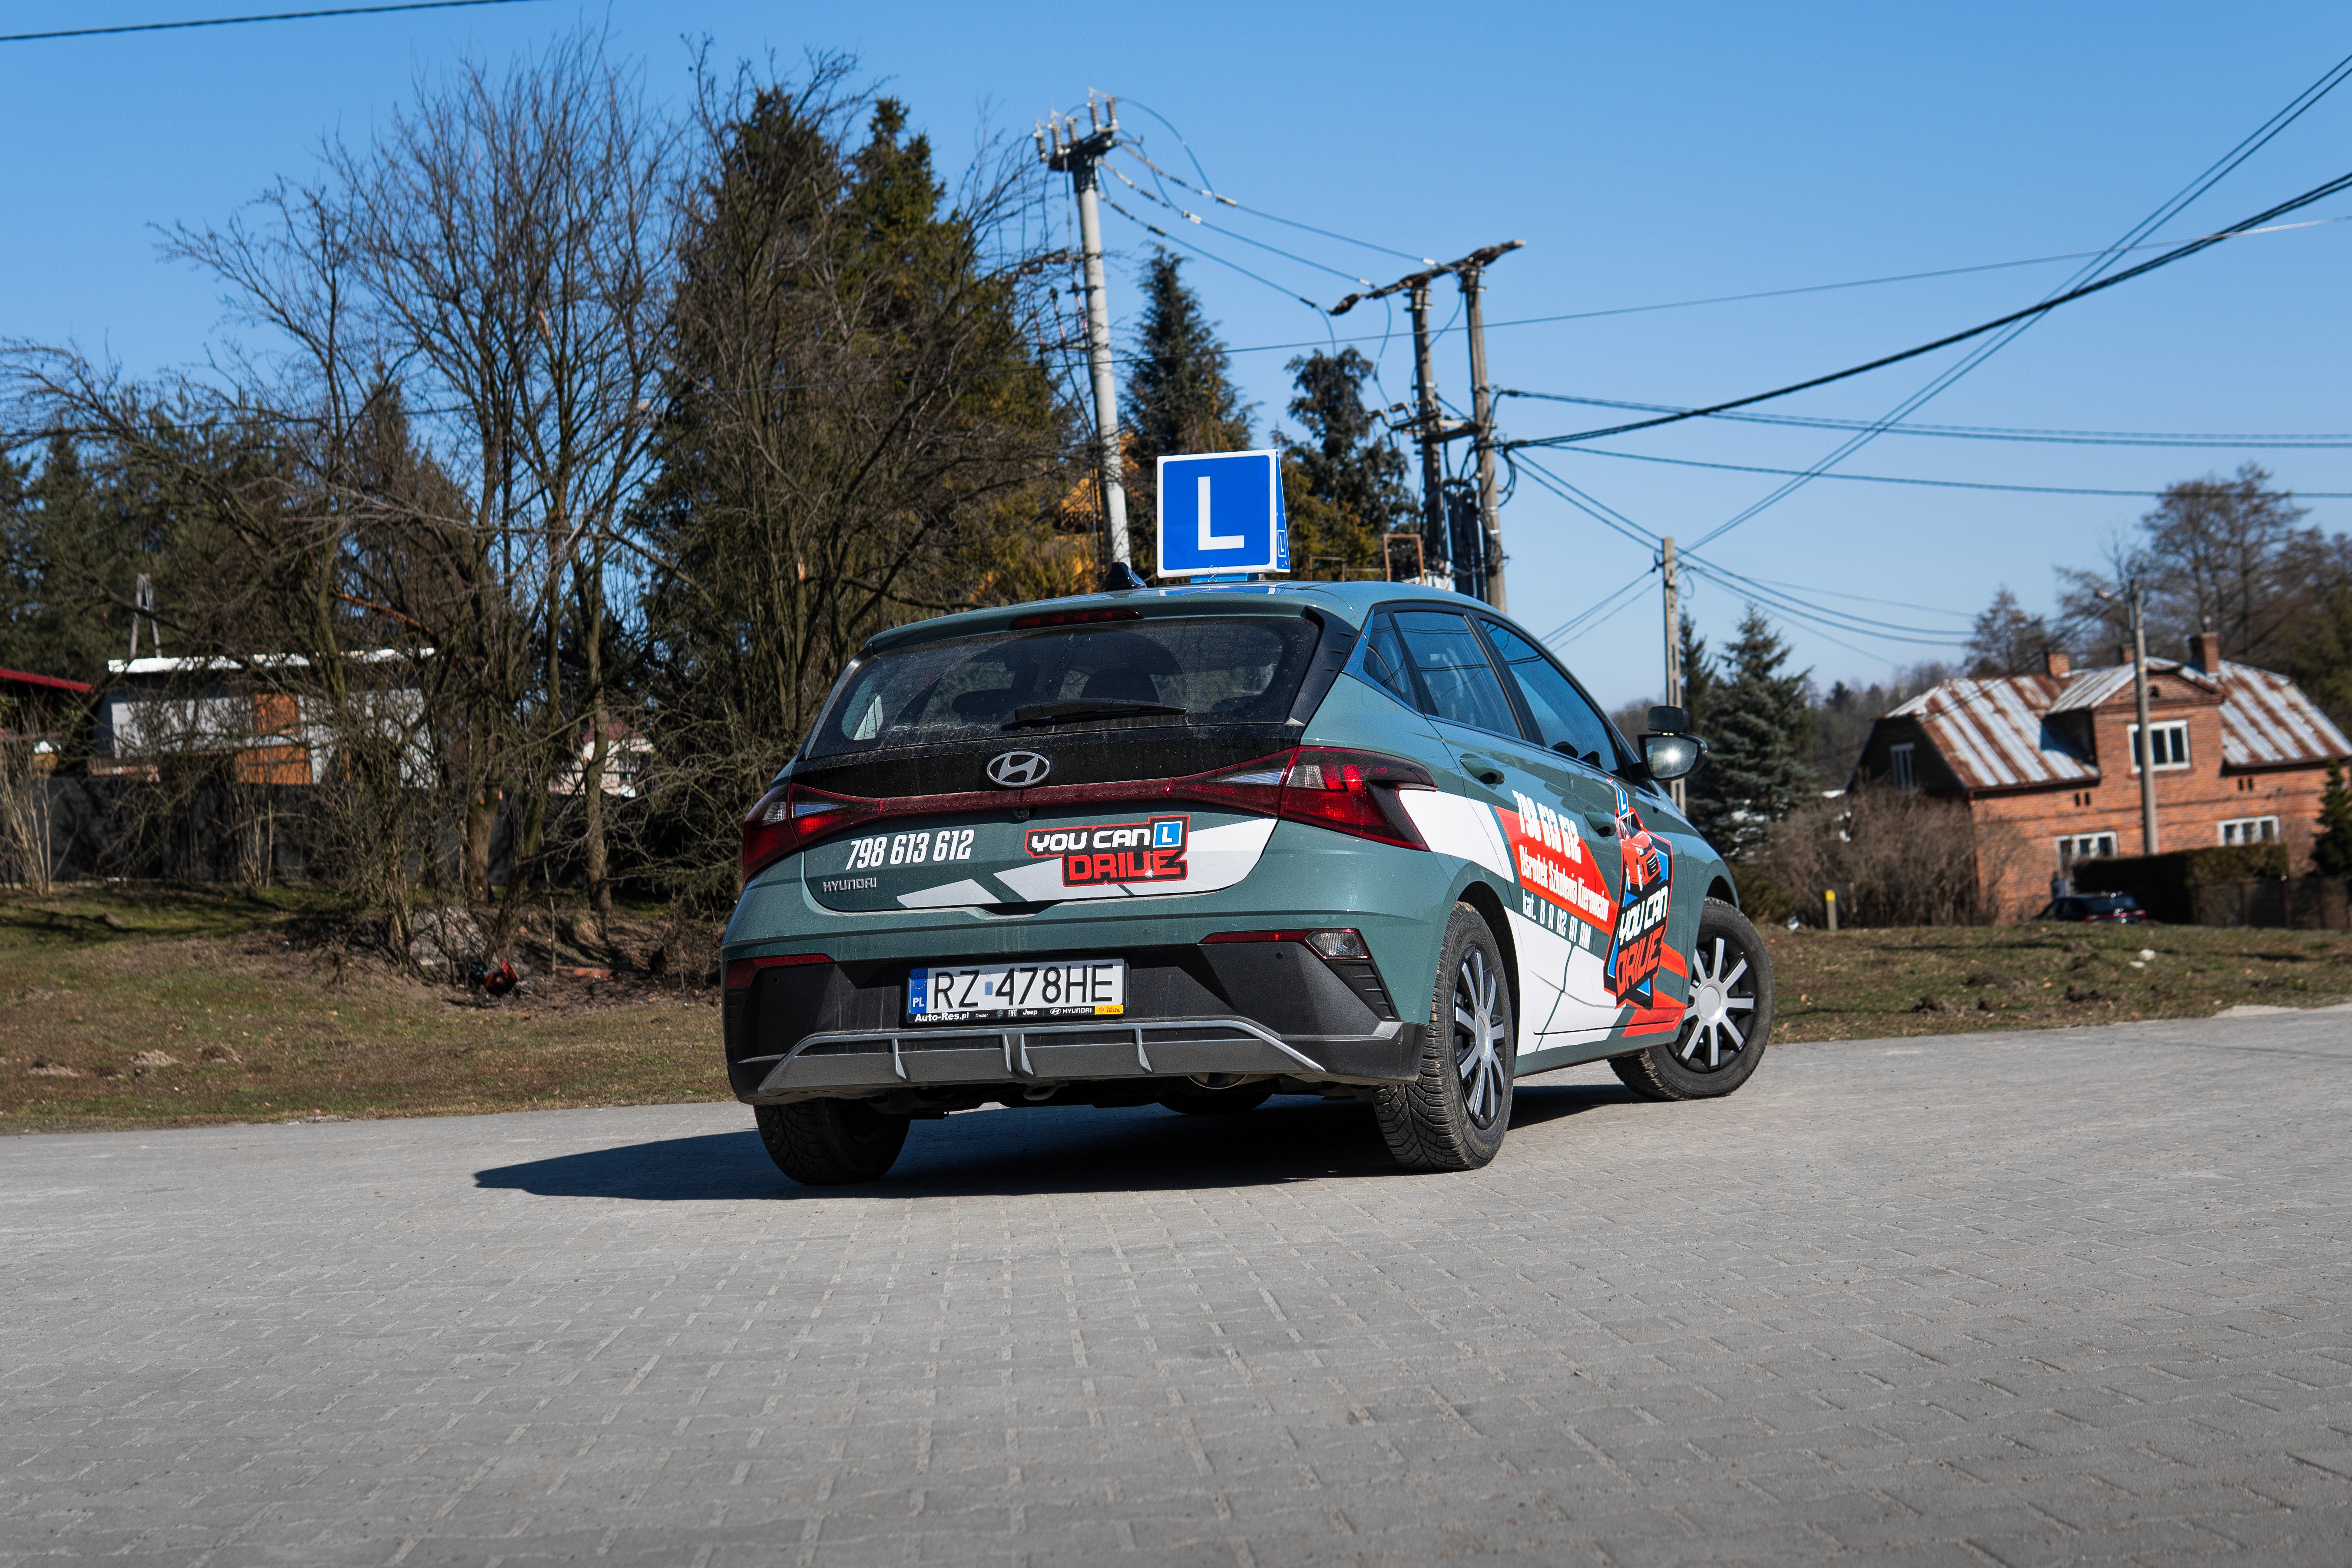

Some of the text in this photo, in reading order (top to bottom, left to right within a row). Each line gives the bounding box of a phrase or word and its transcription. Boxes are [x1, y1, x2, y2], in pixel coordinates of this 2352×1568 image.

[1198, 476, 1244, 551] L
[845, 829, 975, 870] 798 613 612
[1031, 826, 1172, 852] YOU CAN L
[1512, 790, 1581, 864] 798 613 612
[823, 877, 877, 892] HYUNDAI
[1068, 850, 1181, 880] DRIVE
[1519, 844, 1609, 922] Ośrodek Szkolenia Kierowców
[1522, 889, 1591, 950] kat. B A A2 A1 AM
[1618, 886, 1668, 946] YOU CAN
[1616, 925, 1664, 996] DRIVE
[913, 997, 924, 1007] PL
[934, 964, 1113, 1009] RZ 478HE
[915, 1012, 969, 1022] Auto-Res.pl
